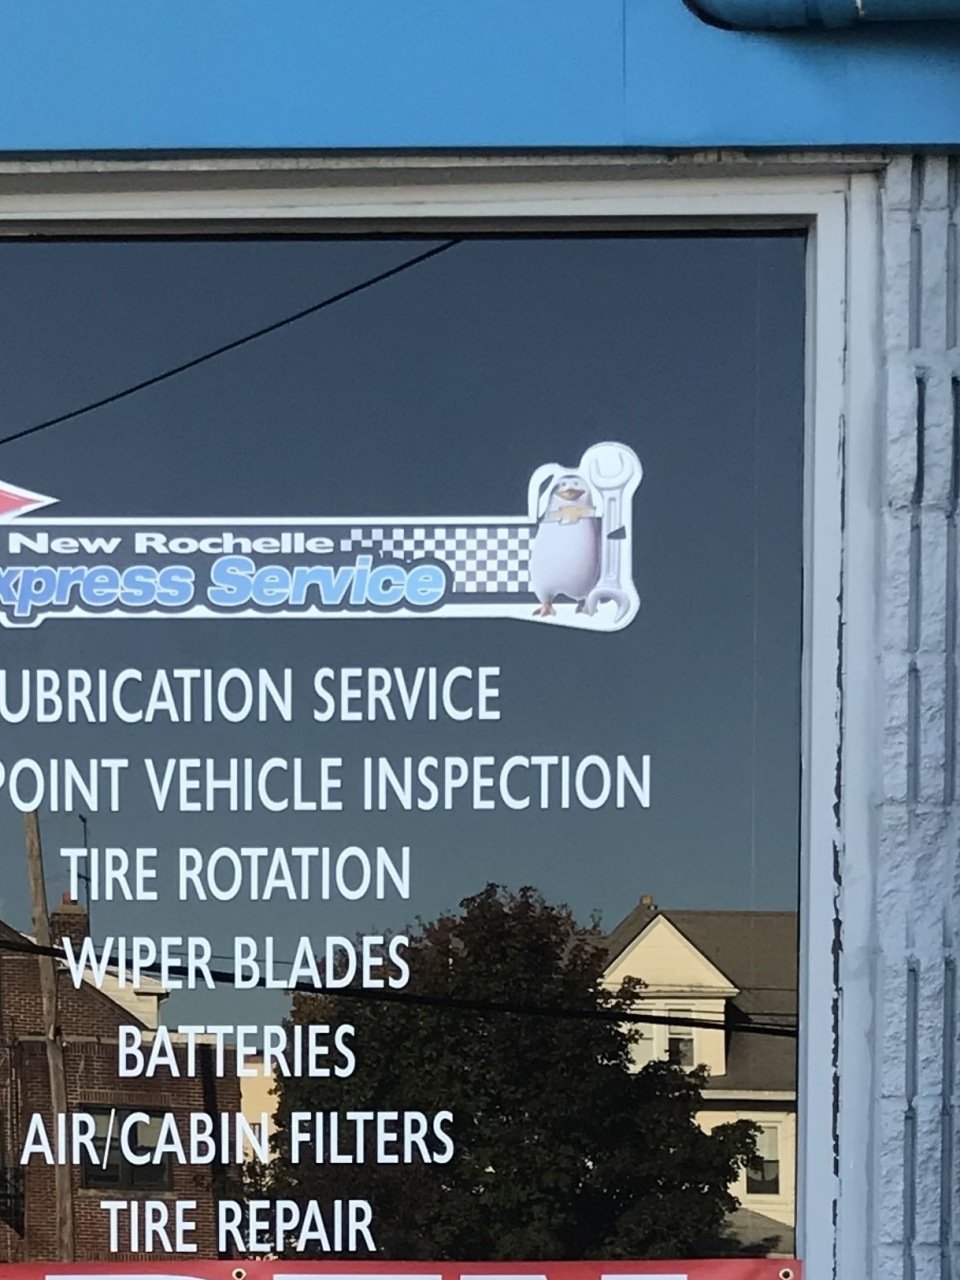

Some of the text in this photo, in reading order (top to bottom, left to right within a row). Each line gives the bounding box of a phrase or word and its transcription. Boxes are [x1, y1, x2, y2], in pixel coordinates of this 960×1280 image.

[8, 531, 334, 554] New Rochelle
[208, 555, 446, 606] Service
[313, 666, 501, 722] SERVICE
[144, 757, 343, 812] VEHICLE
[364, 754, 651, 811] INSPECTION
[60, 846, 411, 901] TIRE ROTATION
[61, 935, 410, 990] WIPER BLADES
[118, 1024, 356, 1079] BATTERIES
[20, 1108, 454, 1170] AIR/CABIN FILTERS
[100, 1199, 377, 1253] TIRE REPAIR
